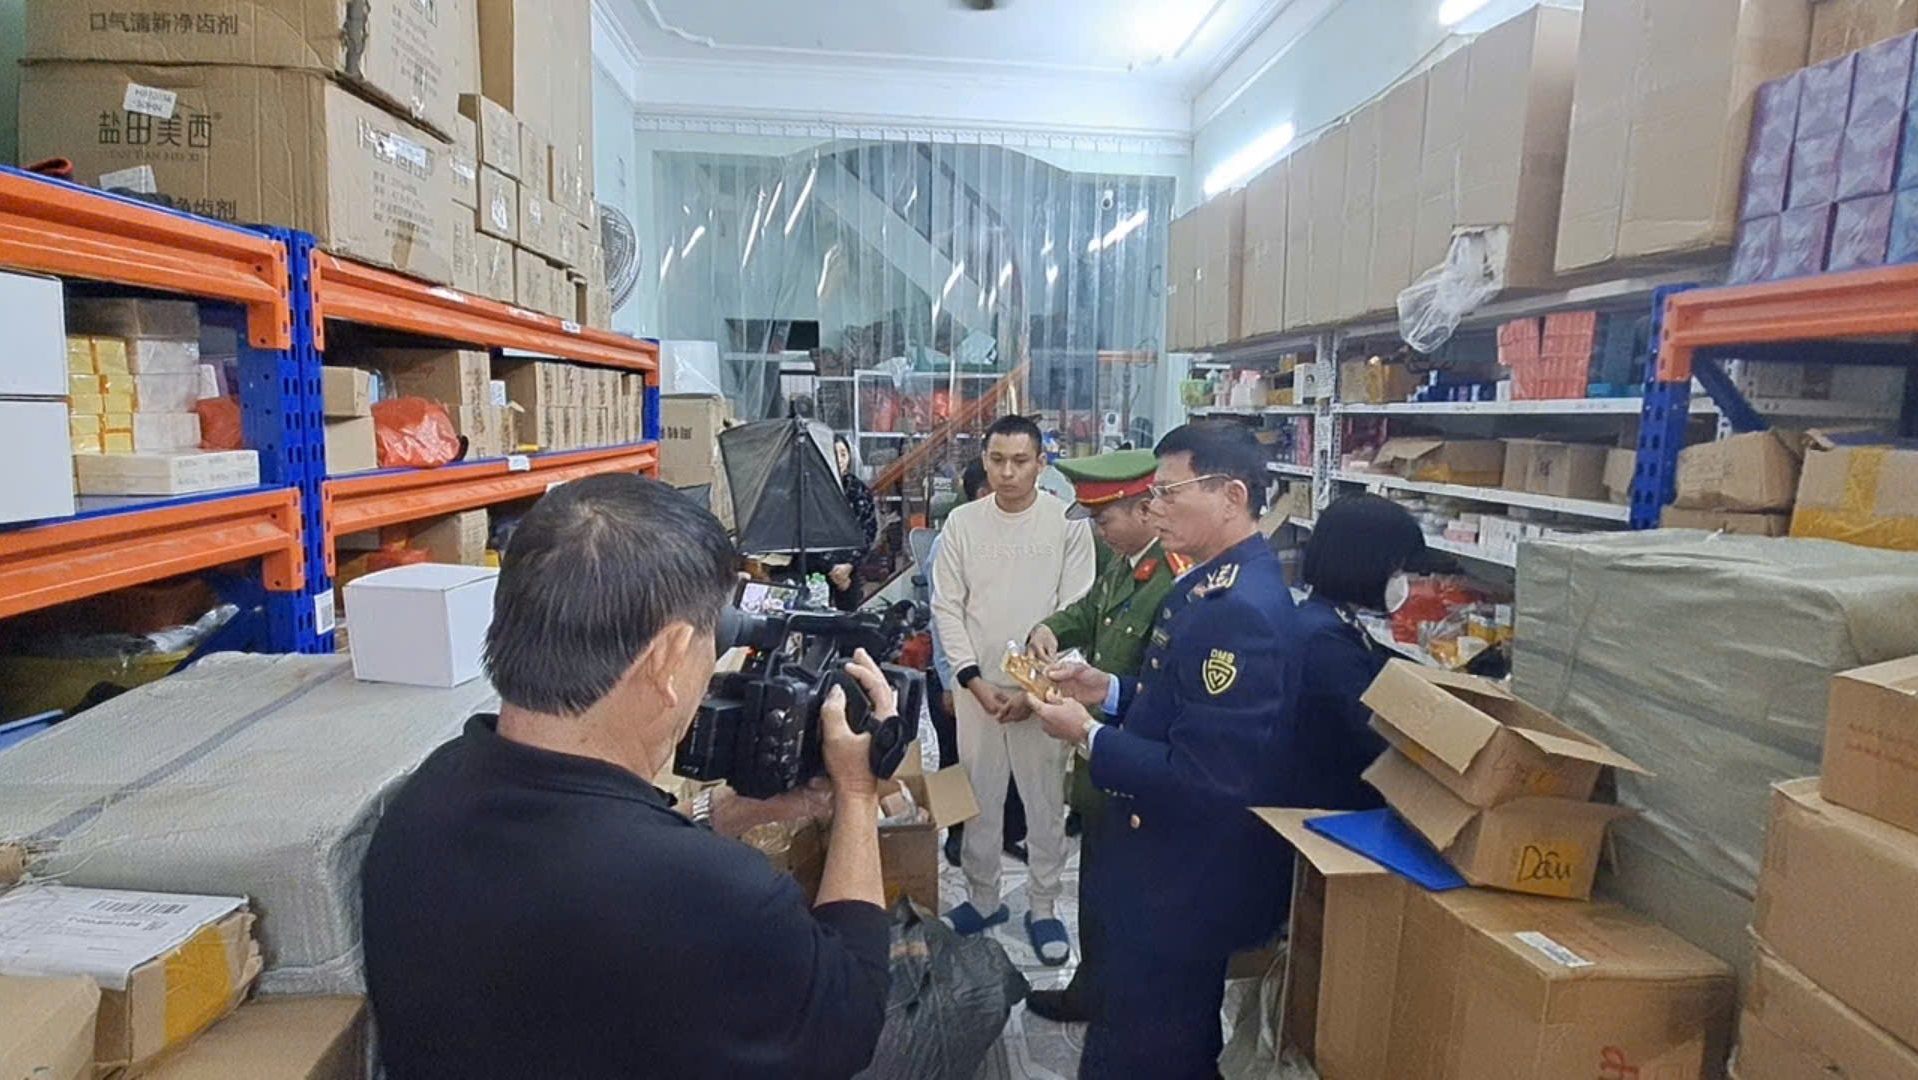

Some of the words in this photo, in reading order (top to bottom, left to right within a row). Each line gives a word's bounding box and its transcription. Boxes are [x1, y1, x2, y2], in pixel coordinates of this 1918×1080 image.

[90, 10, 238, 35] 口气清新净齿剂
